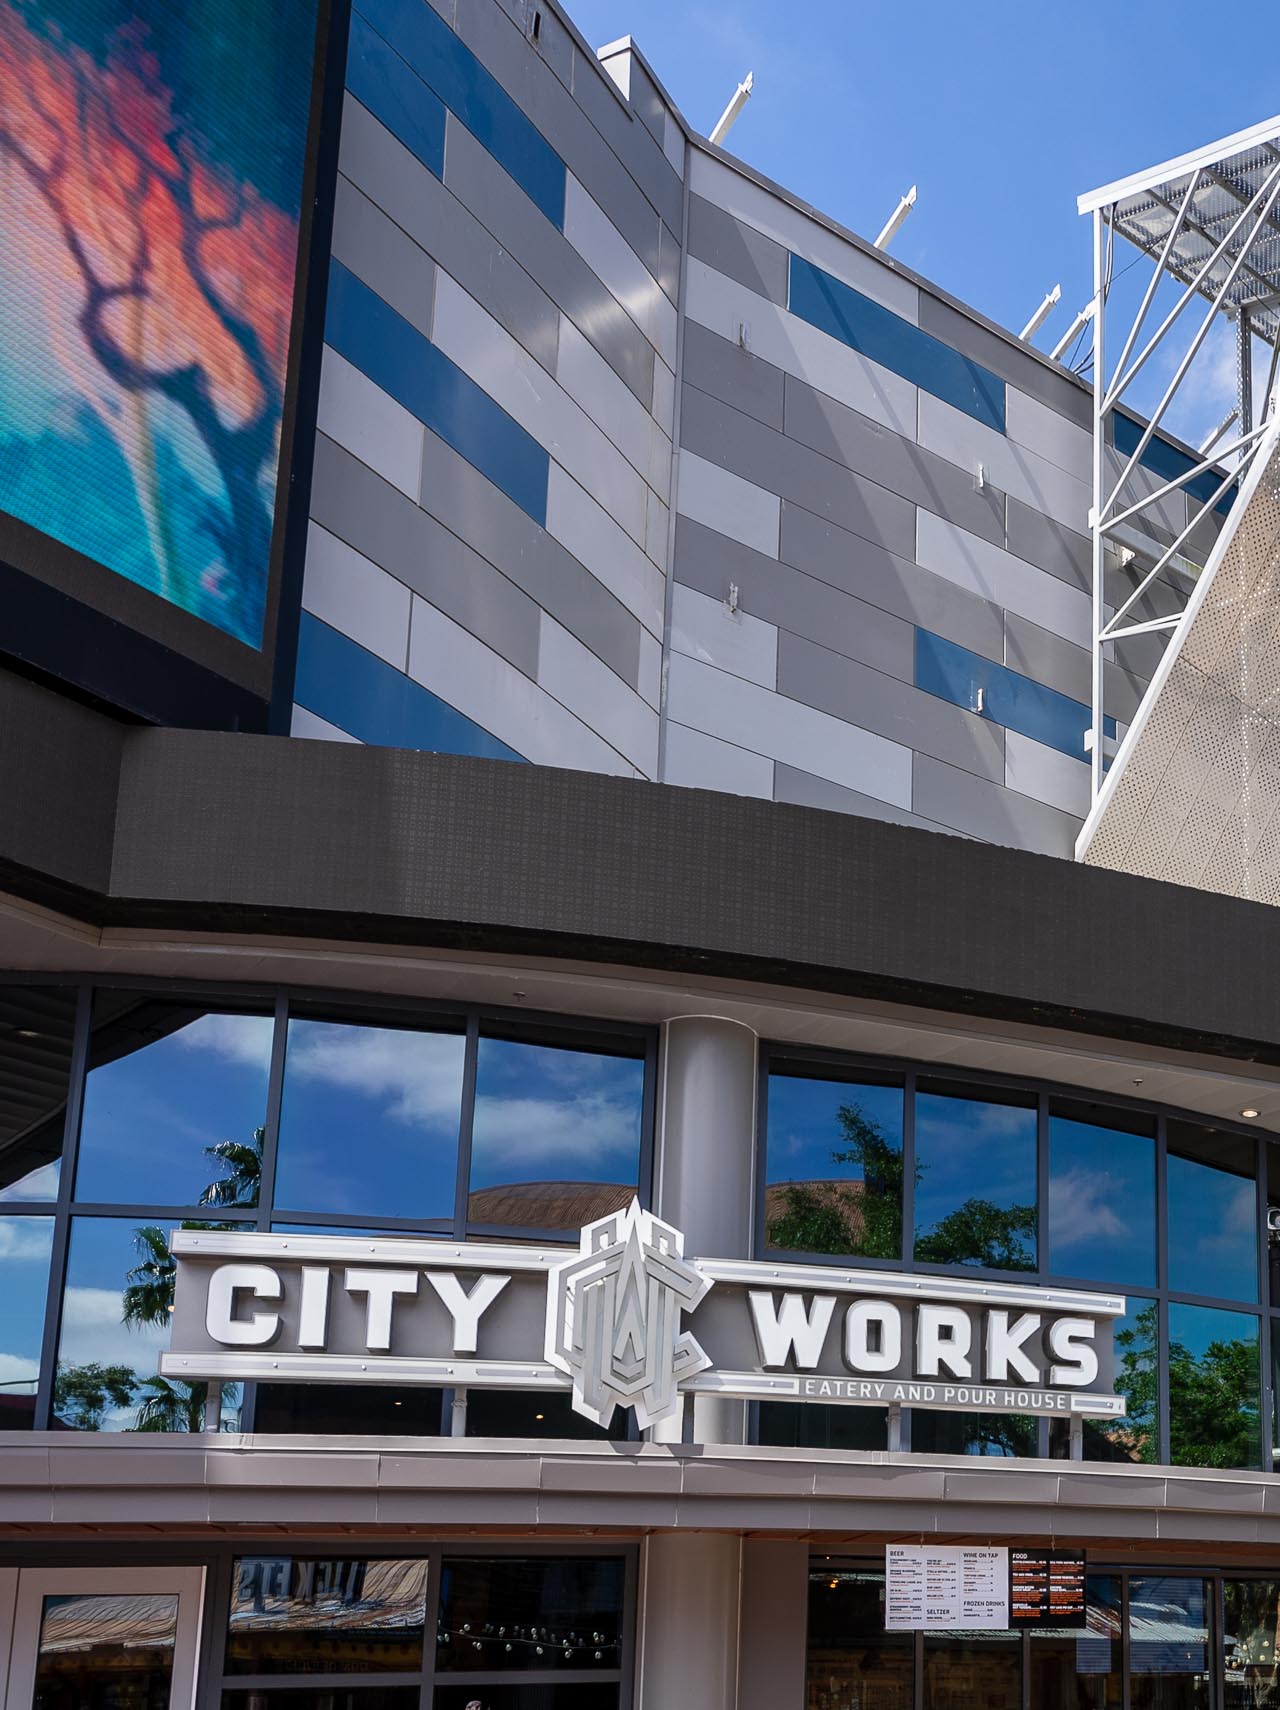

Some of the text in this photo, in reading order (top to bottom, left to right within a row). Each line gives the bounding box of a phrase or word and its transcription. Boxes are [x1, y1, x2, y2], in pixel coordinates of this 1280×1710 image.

[205, 1263, 1099, 1387] CITY WORKS
[805, 1378, 1067, 1410] EATERY AND POUR HOUSE
[926, 1608, 950, 1616] SELTZER
[985, 1600, 1006, 1608] DRINKS
